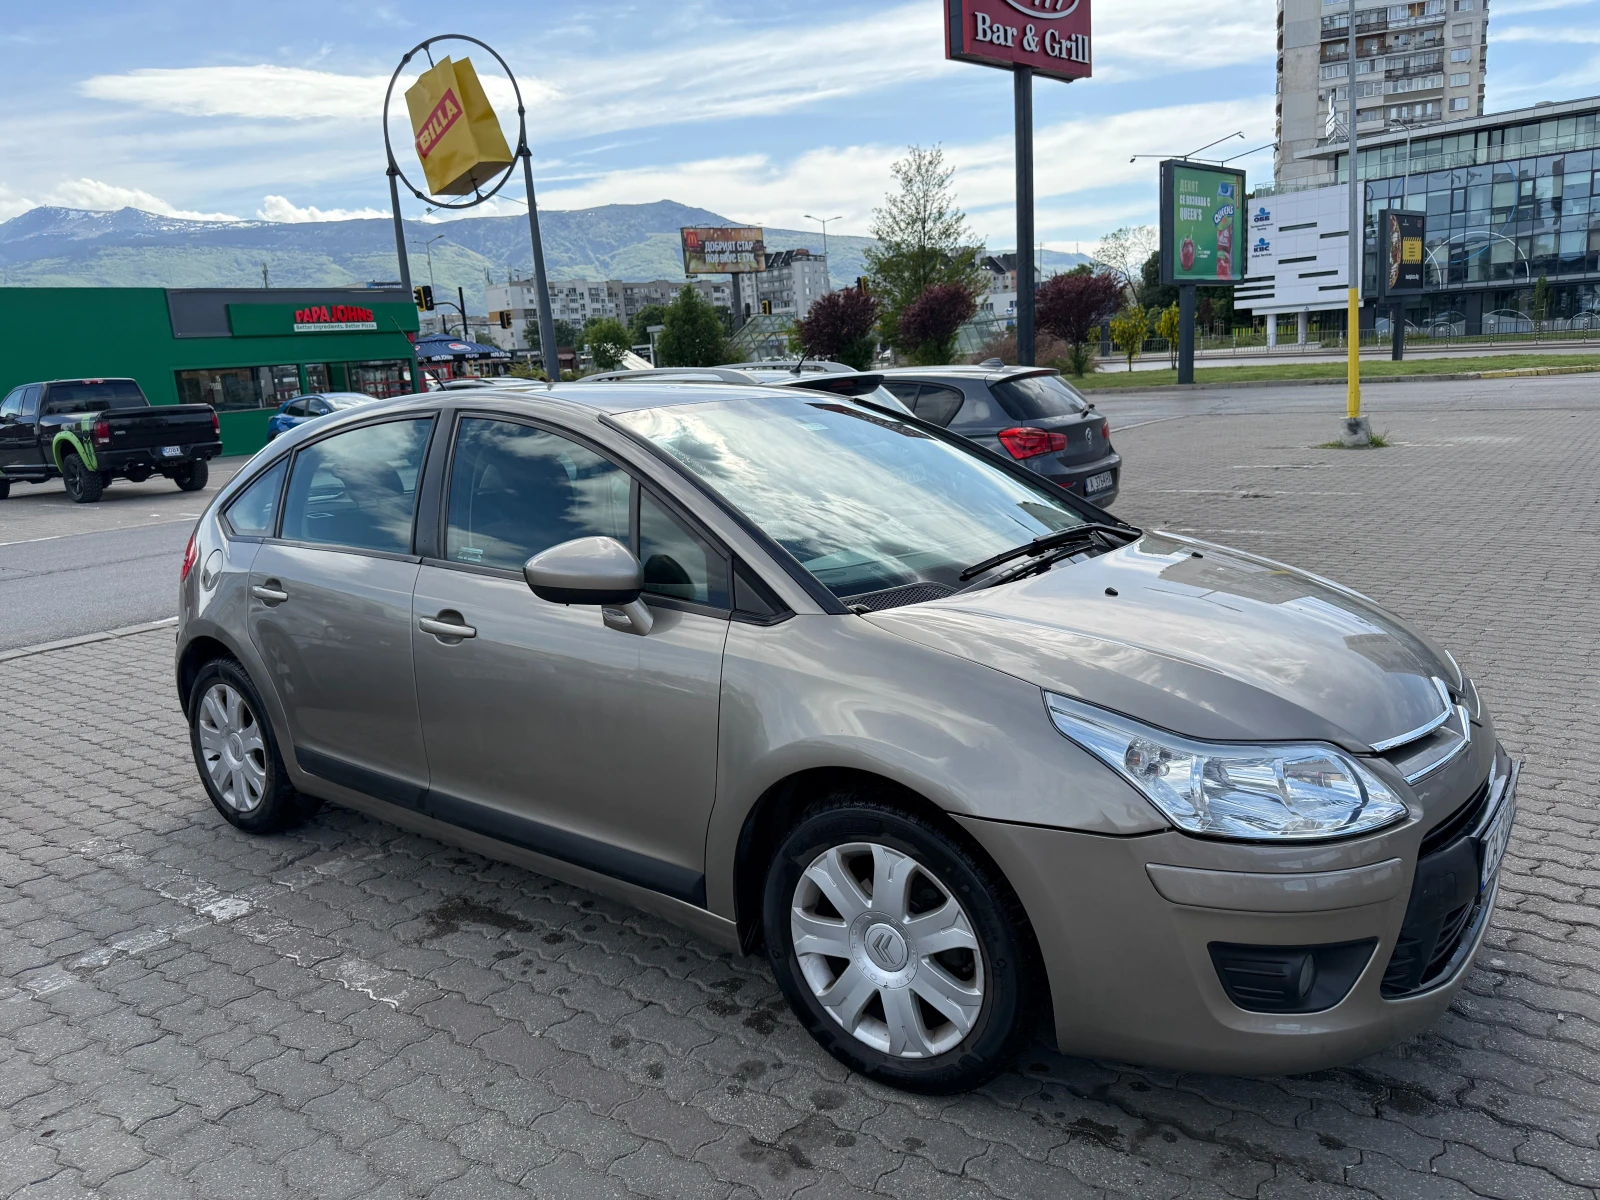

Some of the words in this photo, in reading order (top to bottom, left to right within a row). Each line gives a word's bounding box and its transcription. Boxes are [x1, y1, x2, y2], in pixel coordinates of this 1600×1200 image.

[974, 12, 1017, 47] Bar
[1022, 23, 1040, 53] &
[1044, 28, 1090, 64] Grill
[419, 99, 458, 151] BILLA
[1179, 207, 1203, 221] QUEEN'S
[704, 241, 736, 253] ДОБРИЯТ
[736, 240, 754, 251] СТАР
[705, 254, 719, 263] НОВ
[719, 253, 737, 263] ВКУС
[295, 306, 331, 322] PAPA
[331, 304, 374, 322] JOHNS
